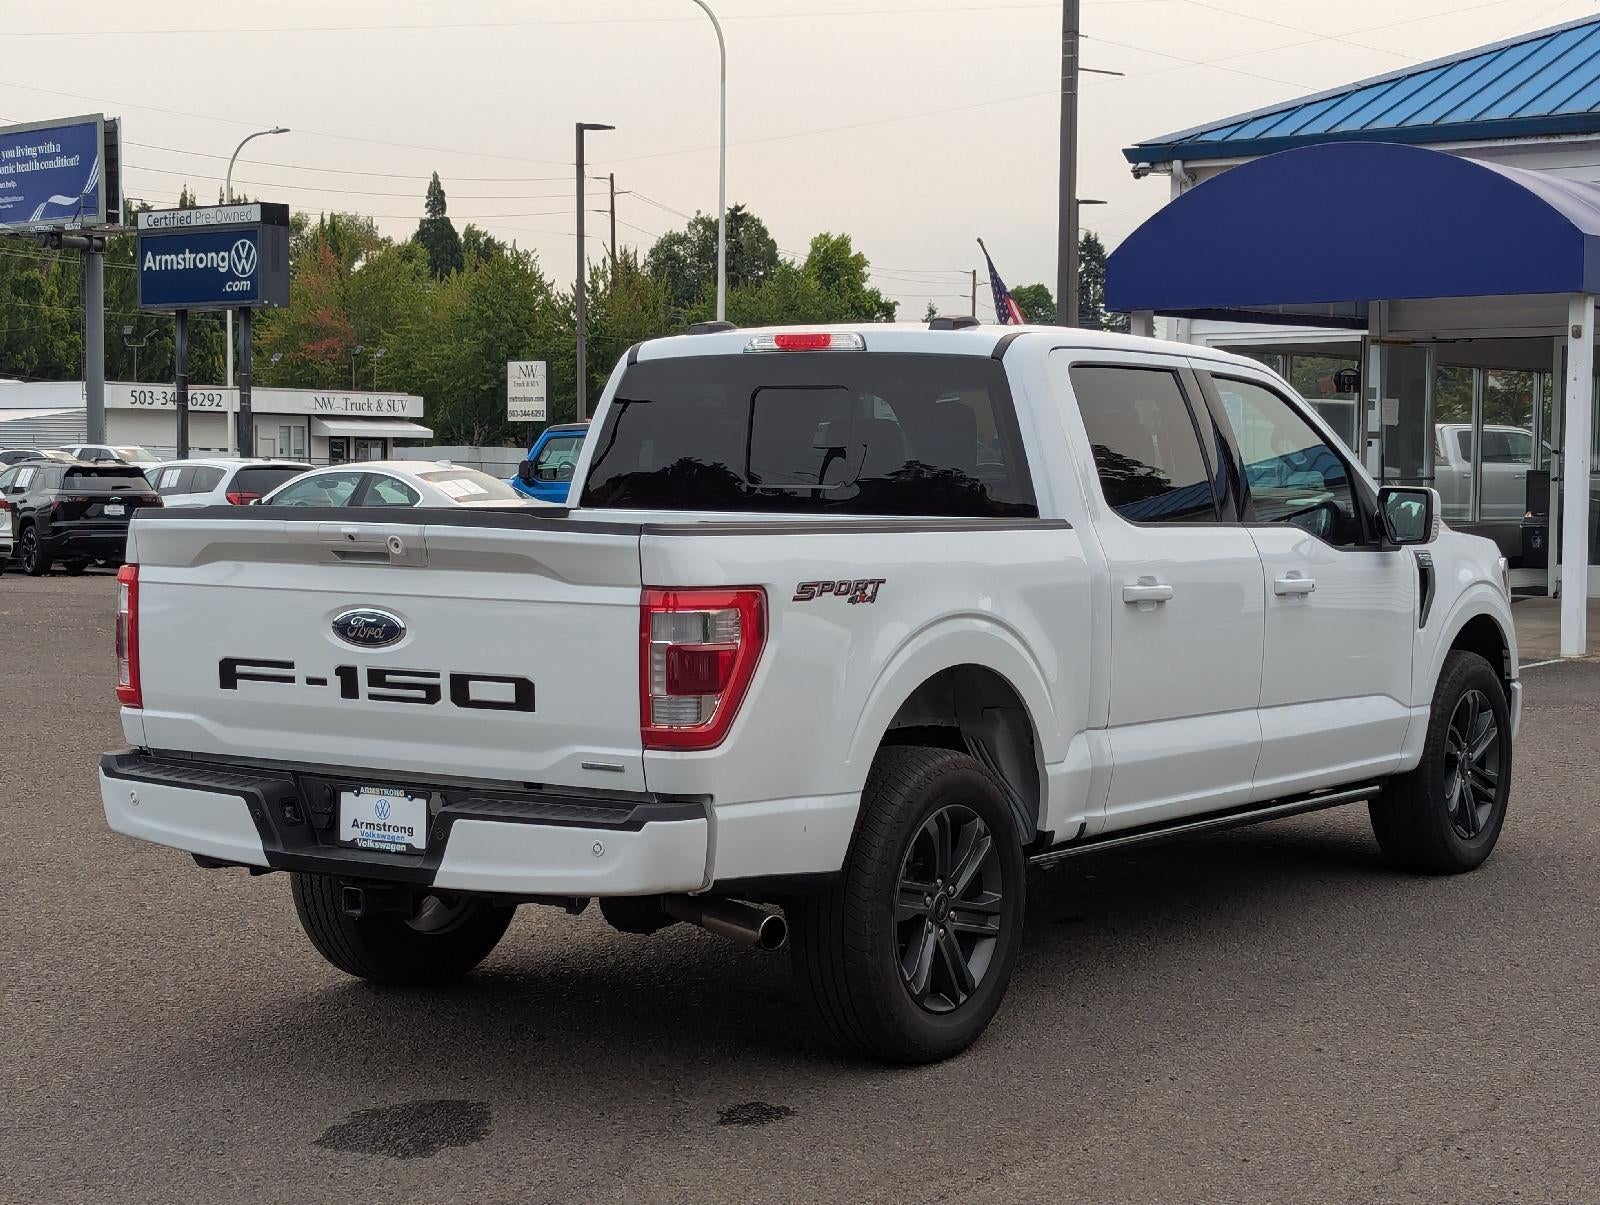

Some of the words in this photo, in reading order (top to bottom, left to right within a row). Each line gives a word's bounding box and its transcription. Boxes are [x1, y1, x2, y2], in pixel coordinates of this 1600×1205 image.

[1, 149, 15, 162] you
[16, 145, 37, 158] living
[38, 141, 55, 154] with
[56, 143, 61, 152] a
[16, 159, 39, 173] health
[40, 154, 79, 169] condition?
[146, 212, 192, 227] Certified
[195, 208, 252, 224] Pre-Owned
[143, 248, 229, 273] Armstrong
[222, 280, 251, 292] .com
[129, 389, 223, 407] 503-34-6292
[314, 396, 335, 410] NW
[343, 397, 373, 412] Truck
[375, 399, 384, 412] &
[386, 399, 408, 413] SUV
[792, 578, 887, 602] SPORT
[347, 616, 387, 639] Ford
[218, 656, 536, 713] F-150
[360, 786, 405, 797] ARMSTRONG
[351, 818, 414, 837] Armstrong
[360, 830, 405, 842] Volkswagen
[357, 838, 407, 852] Volkswagen
